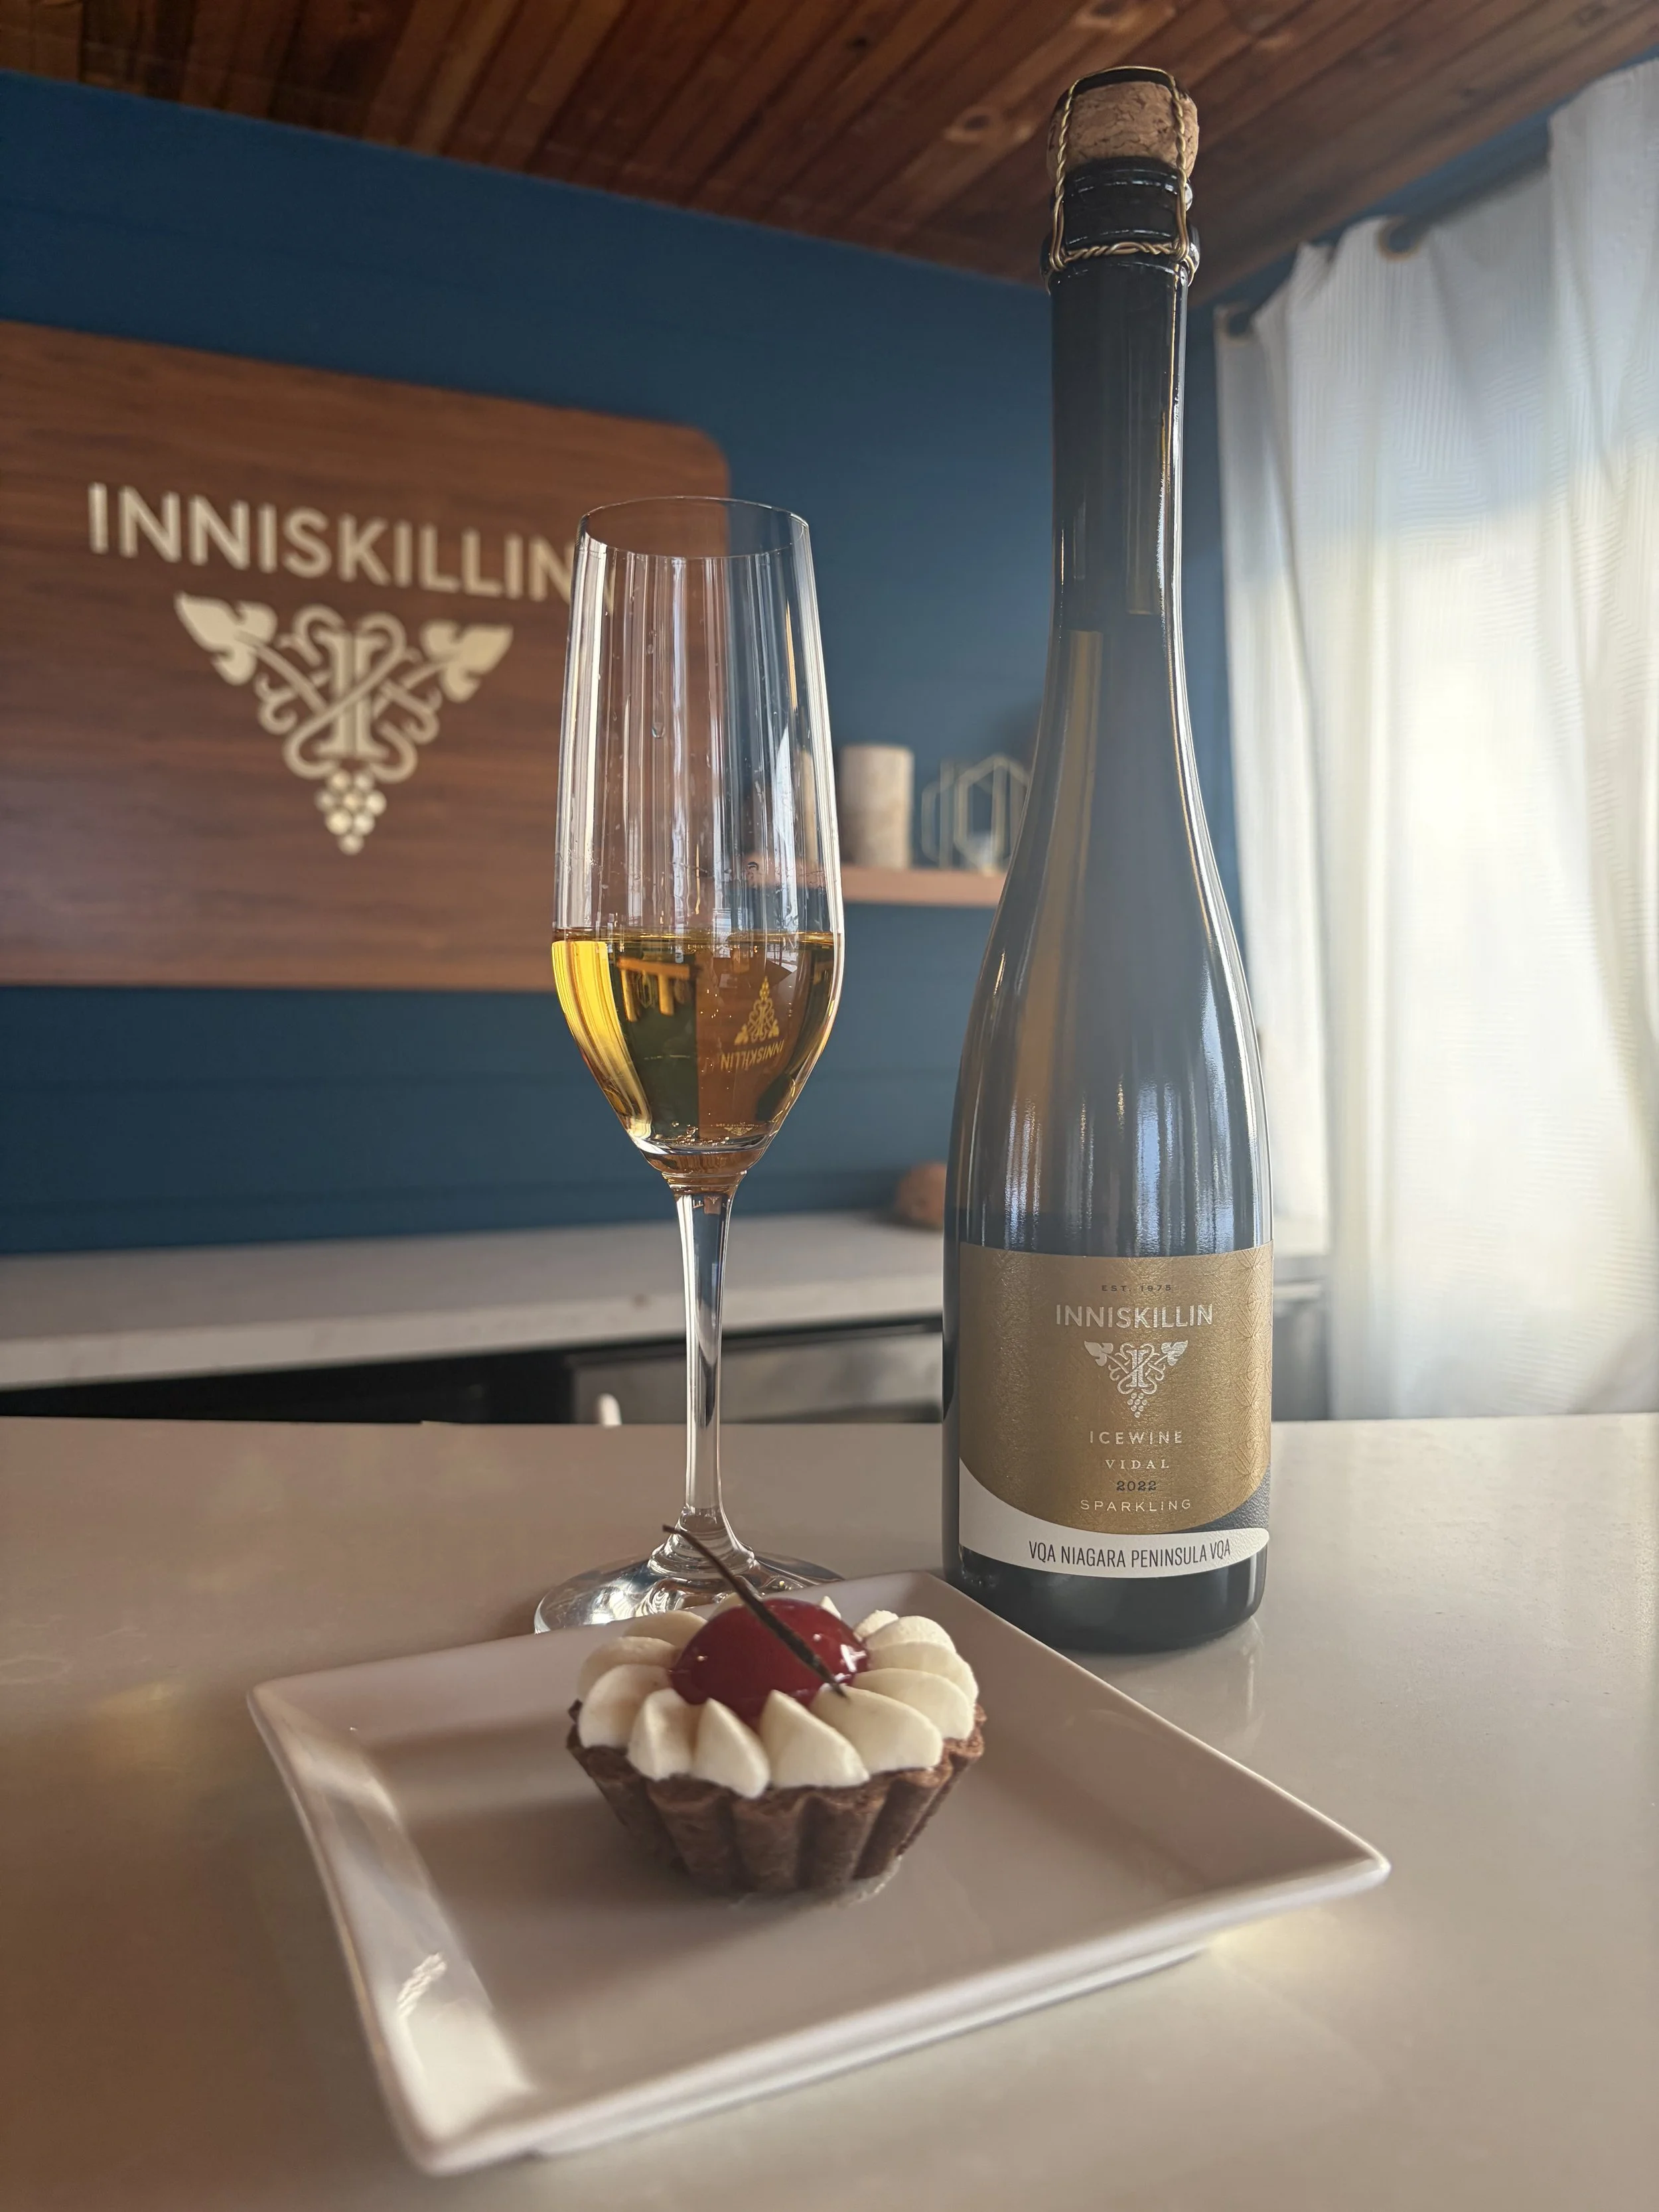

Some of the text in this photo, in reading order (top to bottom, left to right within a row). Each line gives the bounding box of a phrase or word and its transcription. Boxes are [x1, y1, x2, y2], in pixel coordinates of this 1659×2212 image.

[88, 482, 615, 612] INNISKILLIN
[1056, 1304, 1213, 1328] INNISKILLIN
[1089, 1430, 1183, 1445] ICEWINE
[1105, 1459, 1169, 1469] VIDAL
[1116, 1481, 1157, 1491] 2022
[1080, 1499, 1191, 1512] SPARKLING
[1028, 1538, 1231, 1568] VQA NIAGARA PENINSULA VQA
